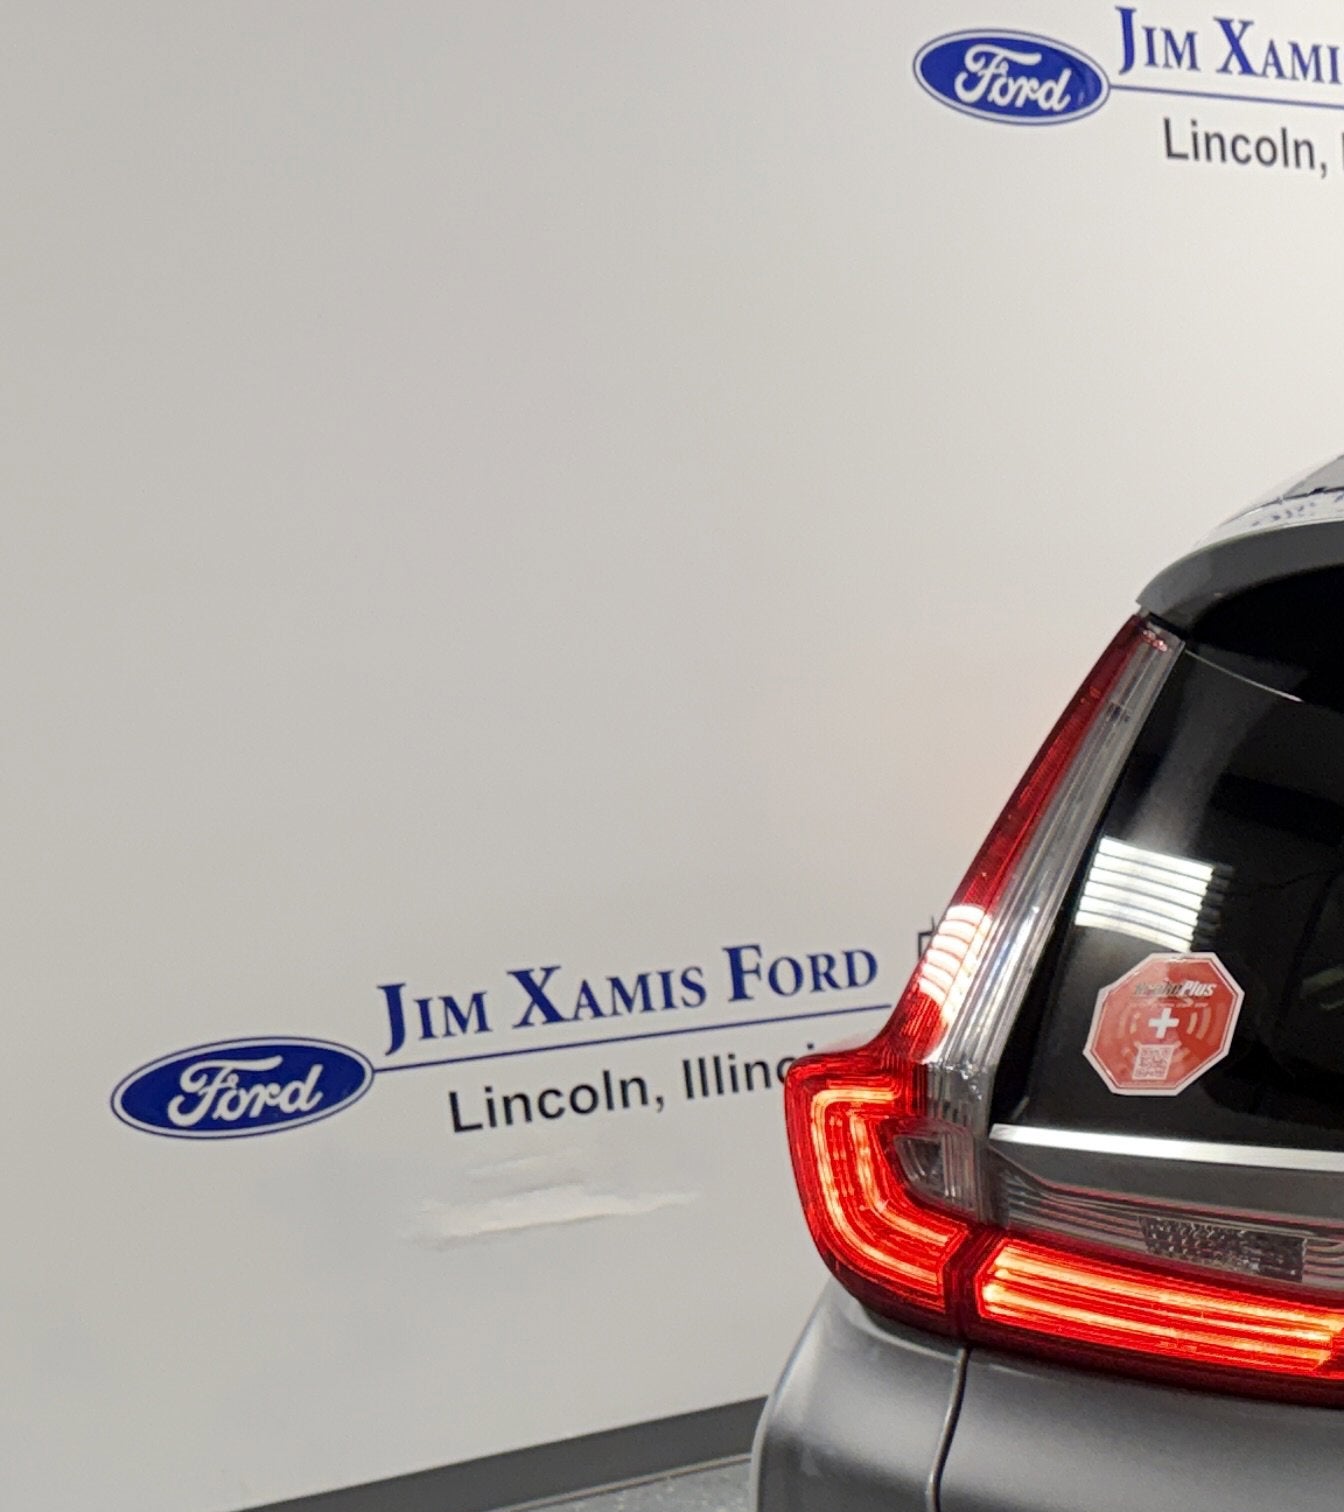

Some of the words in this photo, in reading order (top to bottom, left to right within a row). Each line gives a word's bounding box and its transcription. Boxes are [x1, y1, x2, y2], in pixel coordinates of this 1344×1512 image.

[1115, 6, 1199, 75] JIM
[953, 42, 1071, 112] Ford
[1164, 117, 1329, 178] Lincoln,
[376, 982, 492, 1056] JIM
[506, 965, 707, 1029] XAMIS
[722, 944, 879, 1003] FORD
[167, 1056, 324, 1127] Ford
[448, 1069, 665, 1132] Lincoln,
